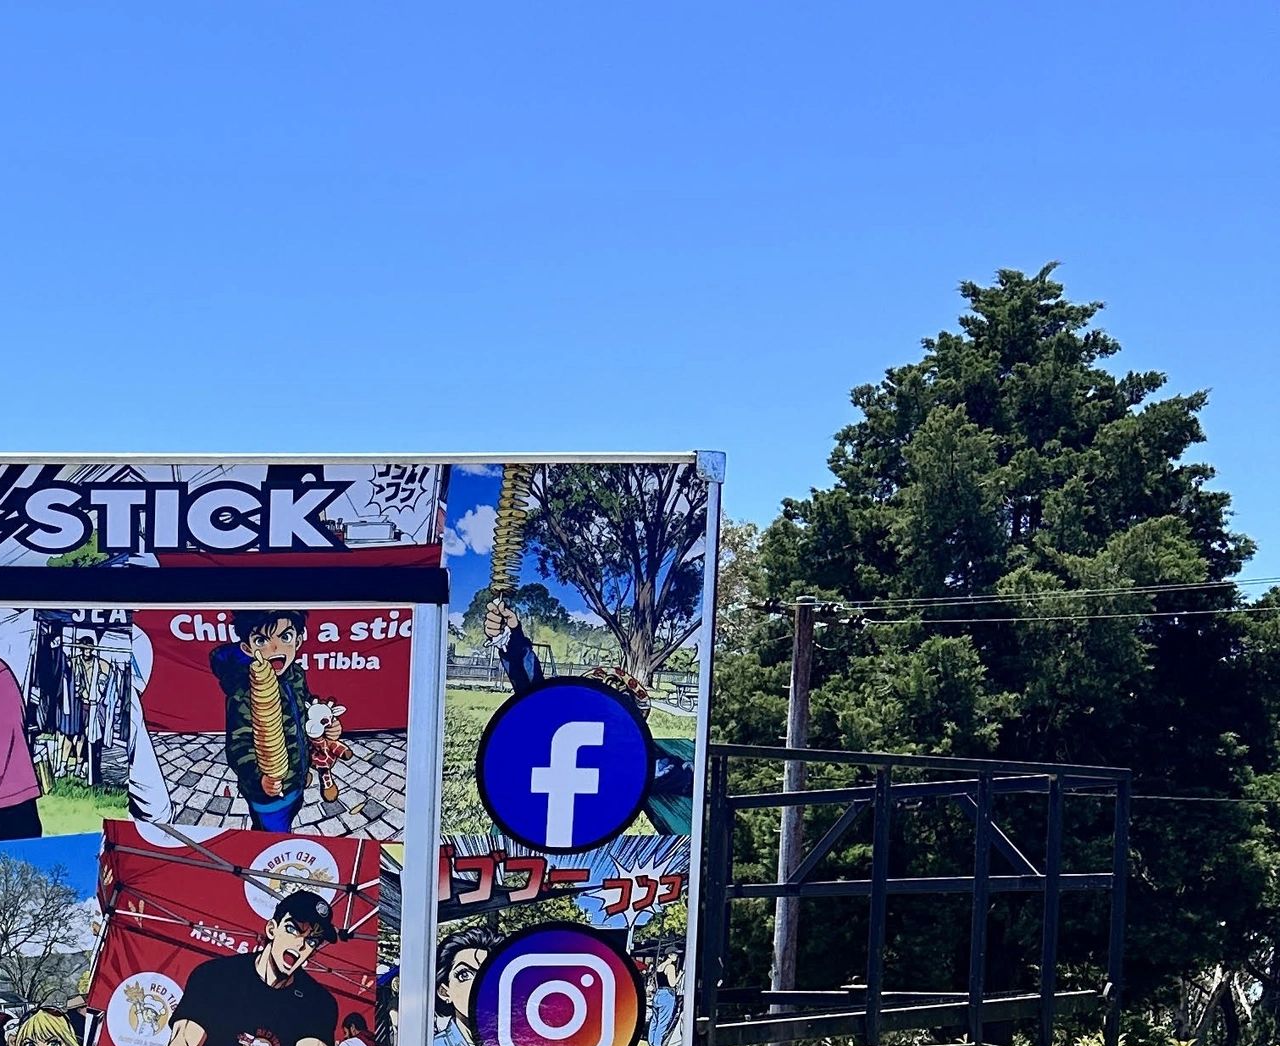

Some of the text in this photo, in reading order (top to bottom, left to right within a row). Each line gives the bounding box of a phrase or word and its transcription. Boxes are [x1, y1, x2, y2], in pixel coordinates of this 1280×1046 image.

[25, 487, 339, 550] STICK
[318, 621, 340, 643] a
[314, 652, 381, 671] Tibba
[150, 982, 168, 996] RED
